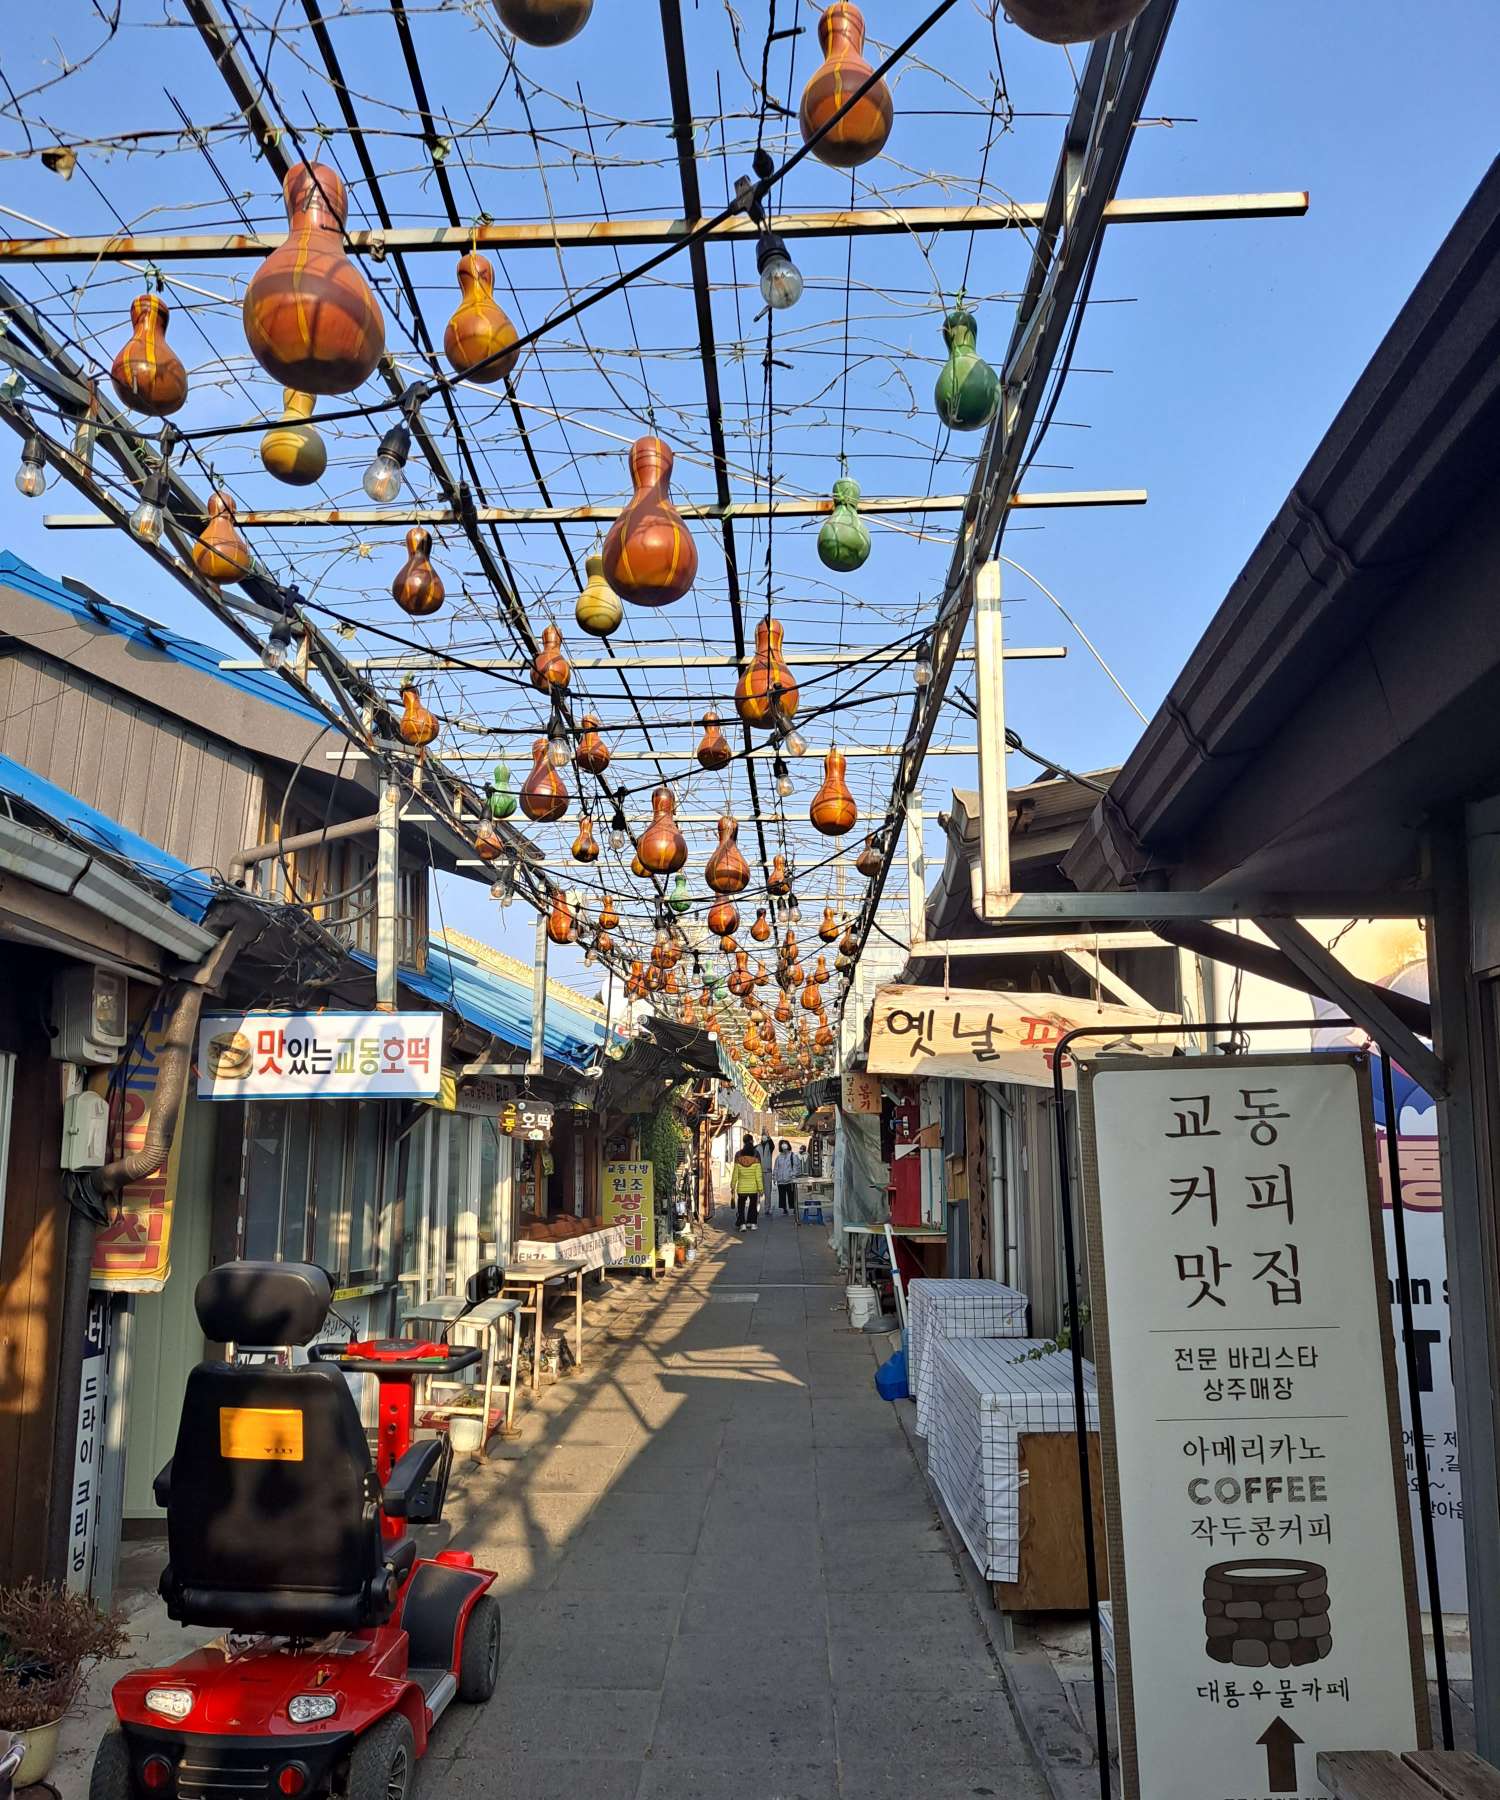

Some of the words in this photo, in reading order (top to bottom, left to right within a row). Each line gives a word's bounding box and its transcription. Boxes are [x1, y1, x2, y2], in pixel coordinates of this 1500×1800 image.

[887, 1009, 1003, 1062] 옛날
[1165, 1088, 1291, 1146] 교동
[612, 1178, 643, 1192] 원조
[1169, 1163, 1295, 1227] 커피
[1174, 1243, 1302, 1308] 맛집
[1174, 1348, 1217, 1372] 전문
[1228, 1345, 1318, 1370] 바리스타
[1203, 1377, 1294, 1402] 상주매장
[79, 1376, 98, 1465] 드라이
[1183, 1434, 1327, 1466] 아메리카노
[1188, 1475, 1328, 1505] COFFEE
[1190, 1514, 1332, 1547] 작두콩커피
